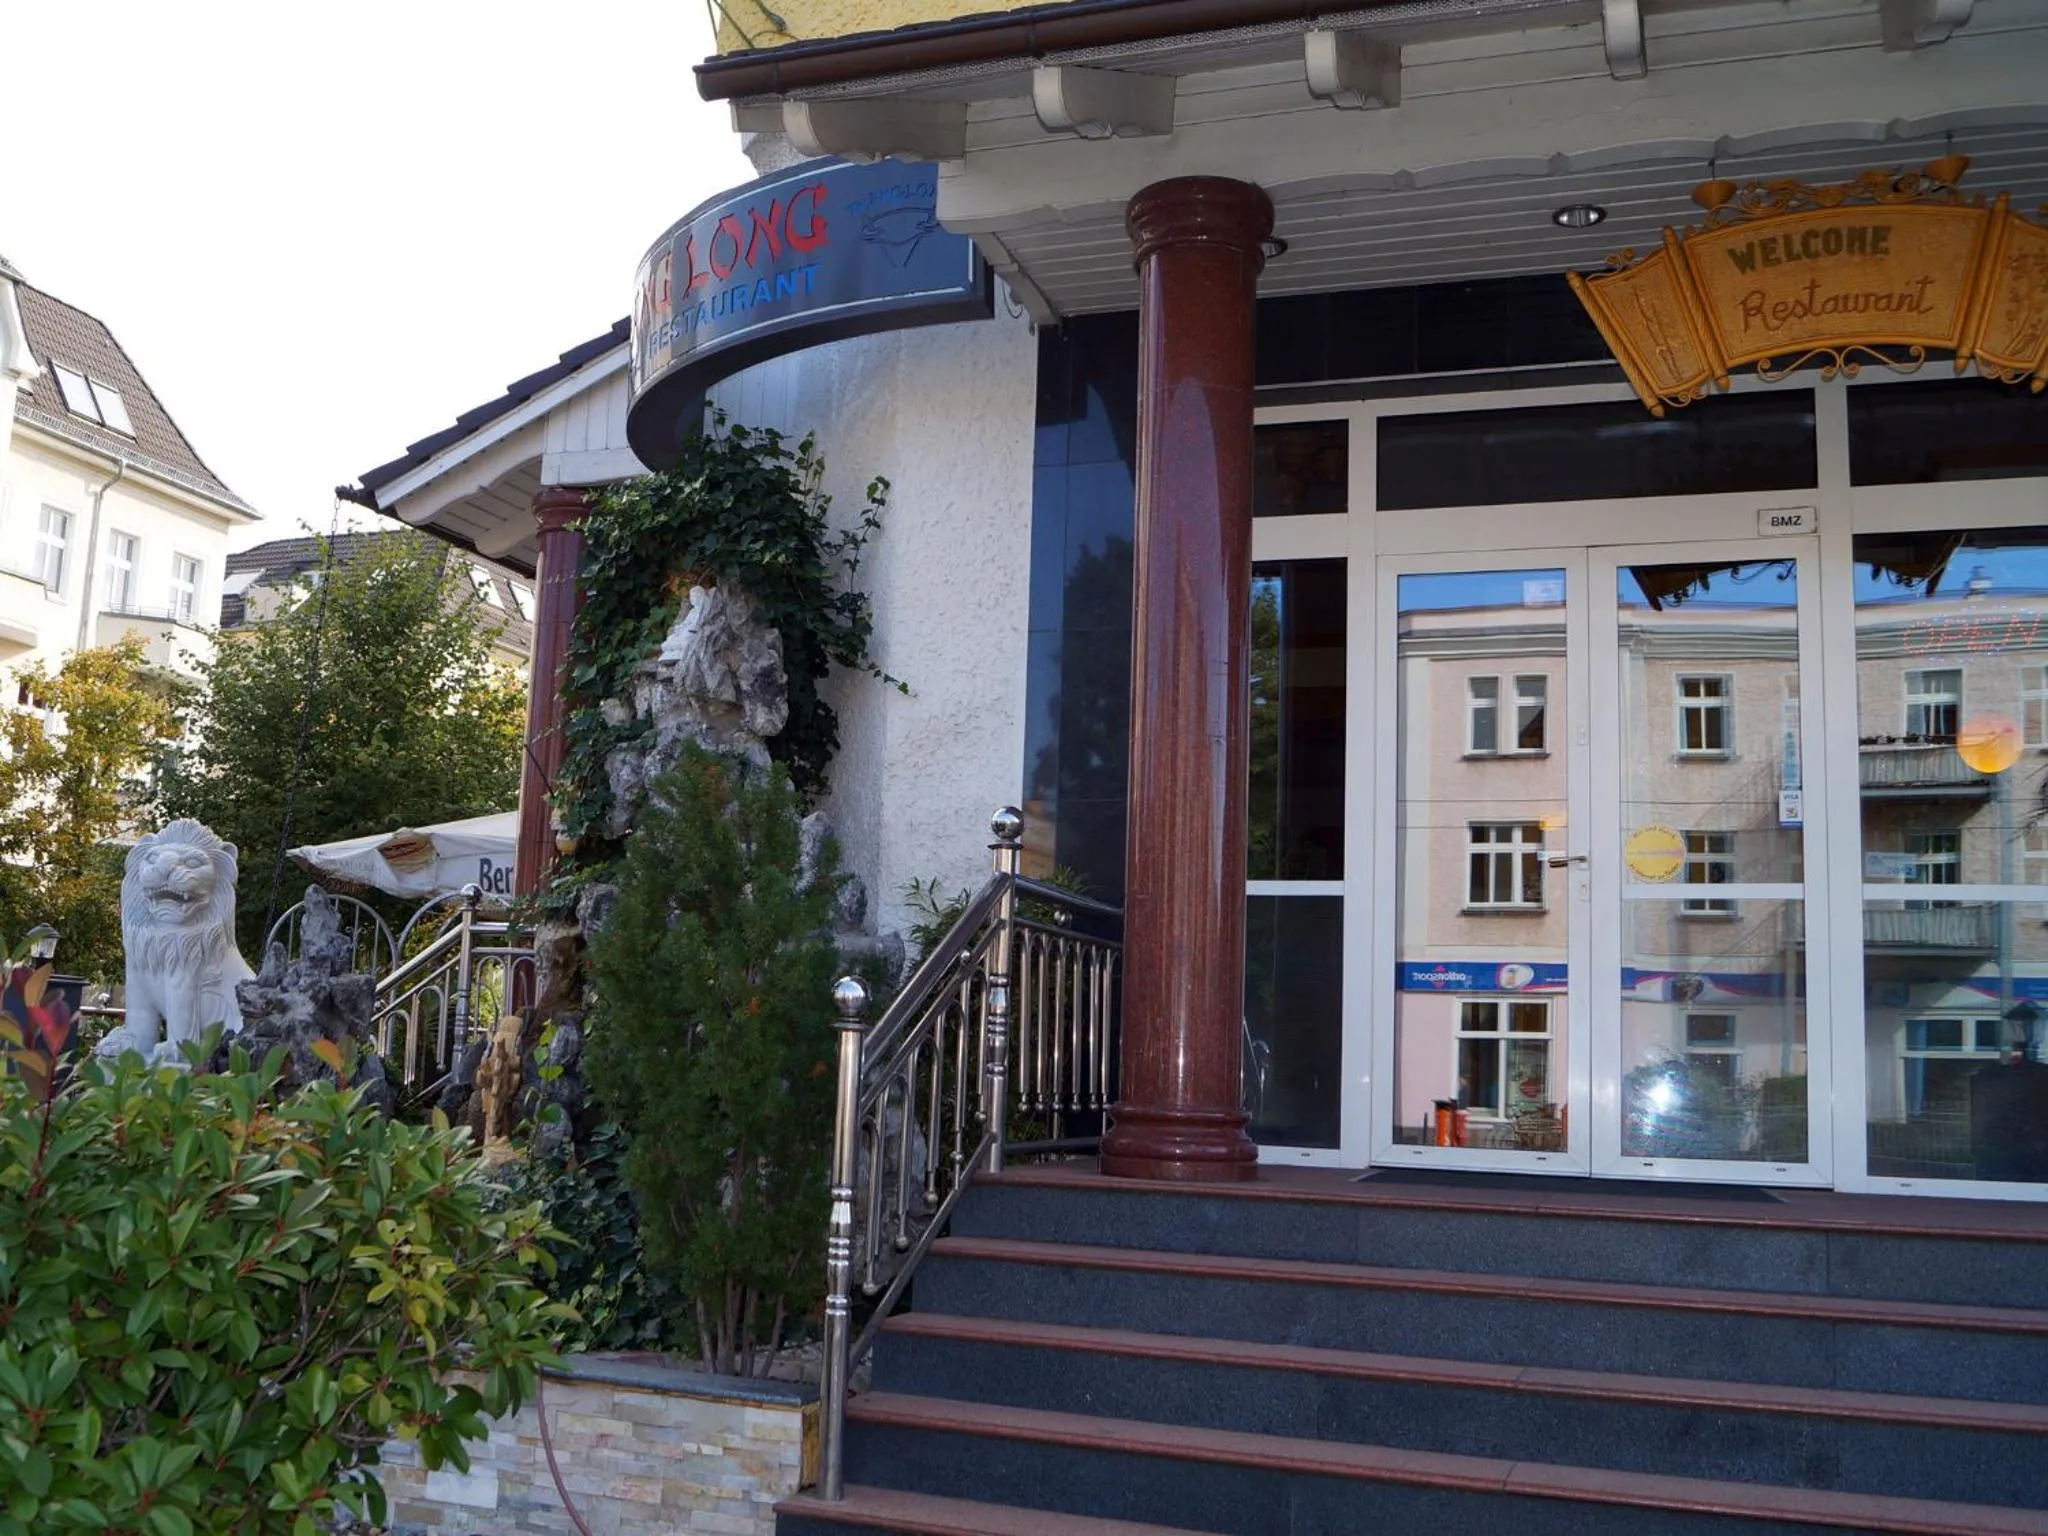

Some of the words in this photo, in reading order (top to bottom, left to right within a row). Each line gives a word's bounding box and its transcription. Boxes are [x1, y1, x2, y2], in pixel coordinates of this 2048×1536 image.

[683, 180, 830, 301] LONG
[1727, 225, 1892, 275] WELCOME
[649, 262, 823, 360] RESTAURANT
[1738, 275, 1935, 333] Restaurant
[1771, 515, 1802, 527] BMZ
